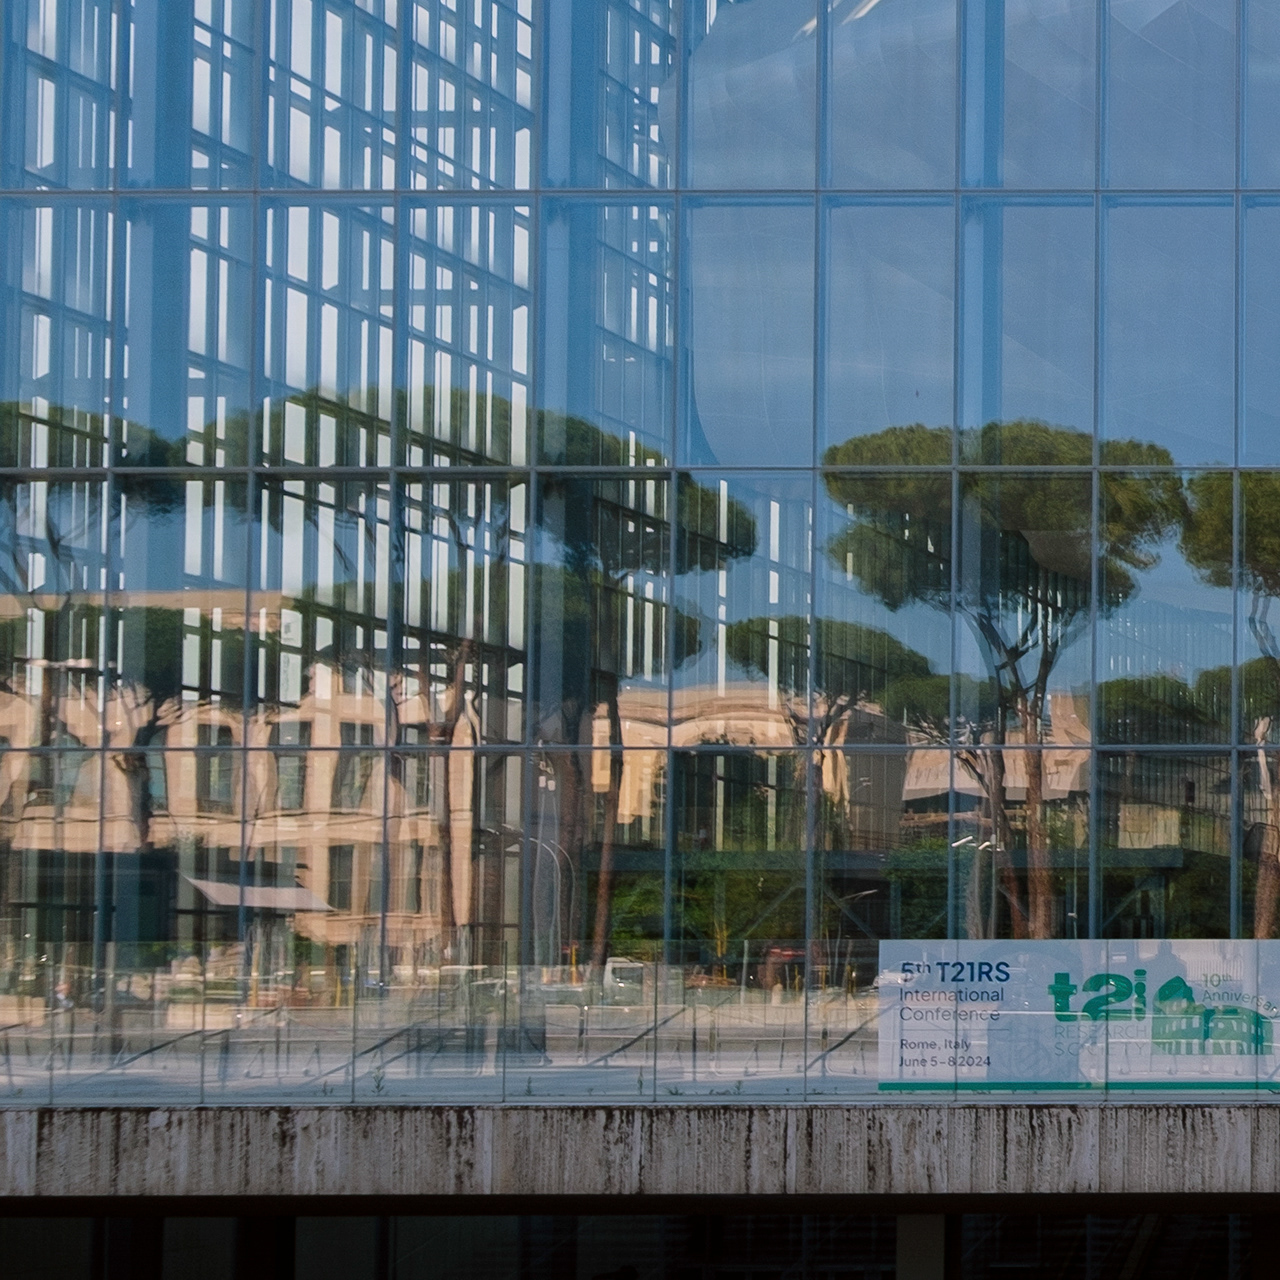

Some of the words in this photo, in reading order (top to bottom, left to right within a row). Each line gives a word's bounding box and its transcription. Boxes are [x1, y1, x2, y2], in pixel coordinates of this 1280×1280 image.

[901, 961, 931, 982] 5th
[936, 961, 1011, 982] T21RS
[1203, 973, 1232, 988] 10th
[900, 987, 1004, 1001] International
[900, 1006, 1001, 1021] Conference
[1054, 1024, 1147, 1039] RESEARCH
[901, 1039, 942, 1051] Rome,
[945, 1039, 972, 1052] Italy
[899, 1056, 928, 1067] June
[958, 1056, 991, 1067] 2024
